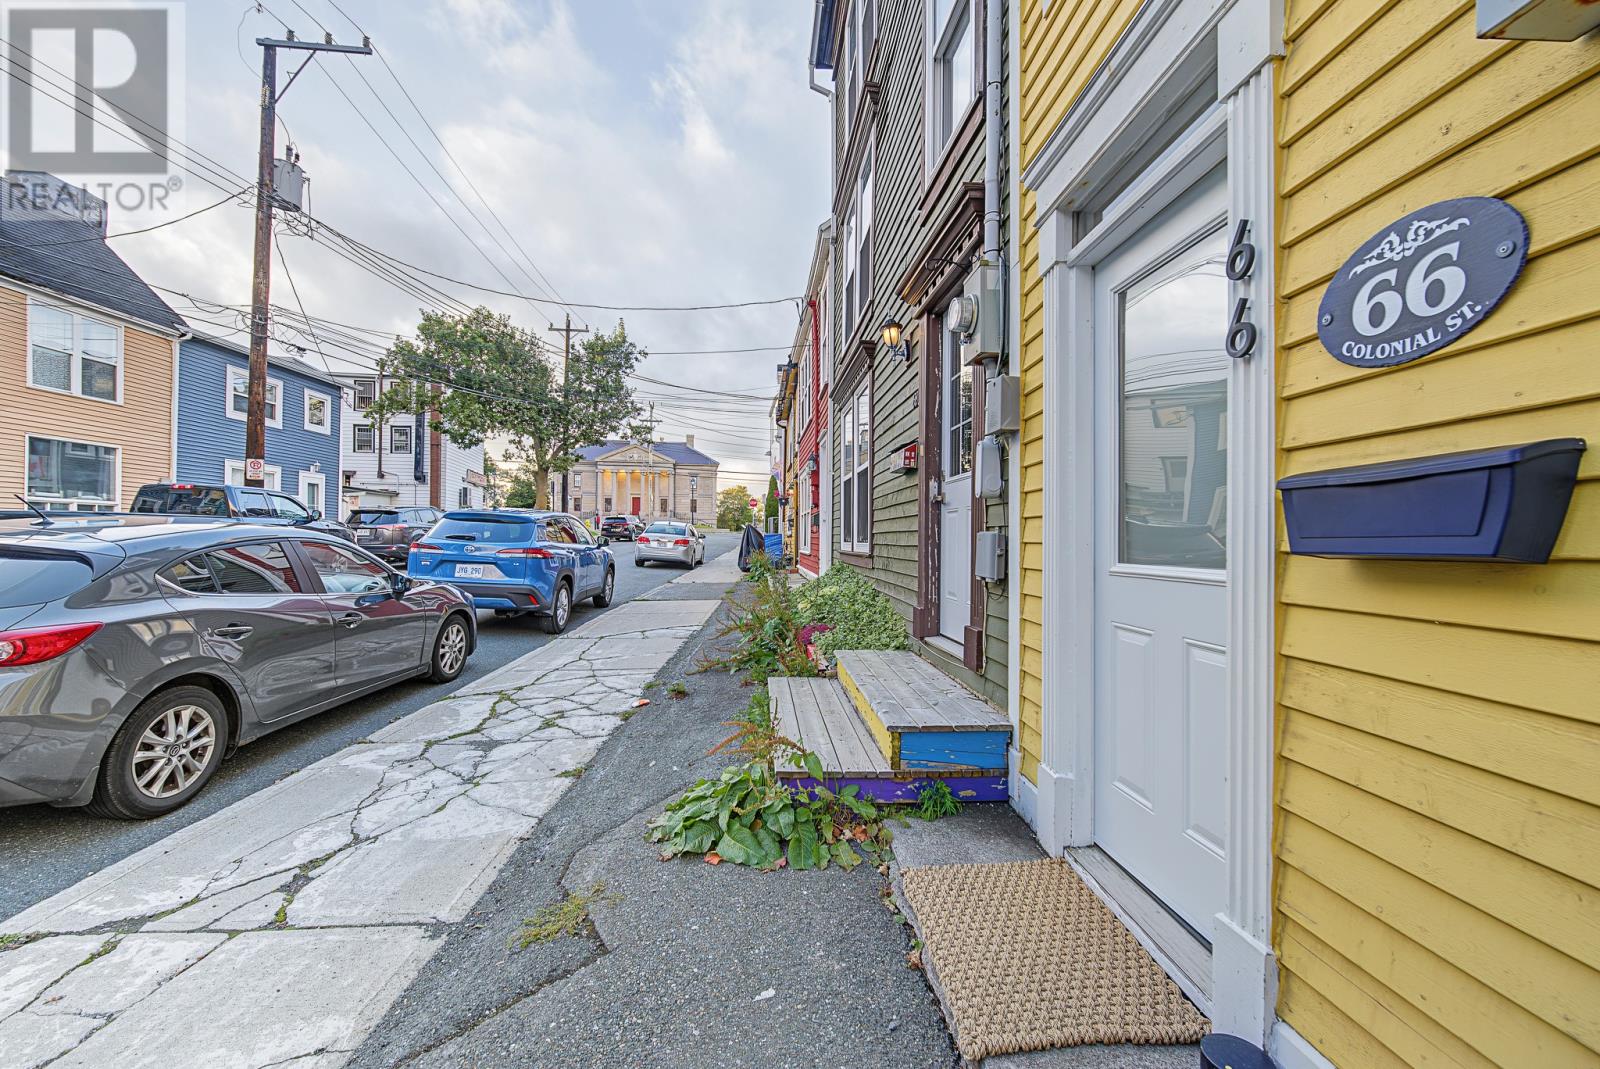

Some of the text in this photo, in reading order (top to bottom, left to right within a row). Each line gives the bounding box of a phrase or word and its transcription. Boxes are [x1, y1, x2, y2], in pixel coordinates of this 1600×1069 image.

[1352, 241, 1466, 336] 66
[1341, 301, 1481, 359] COLONIAL ST.
